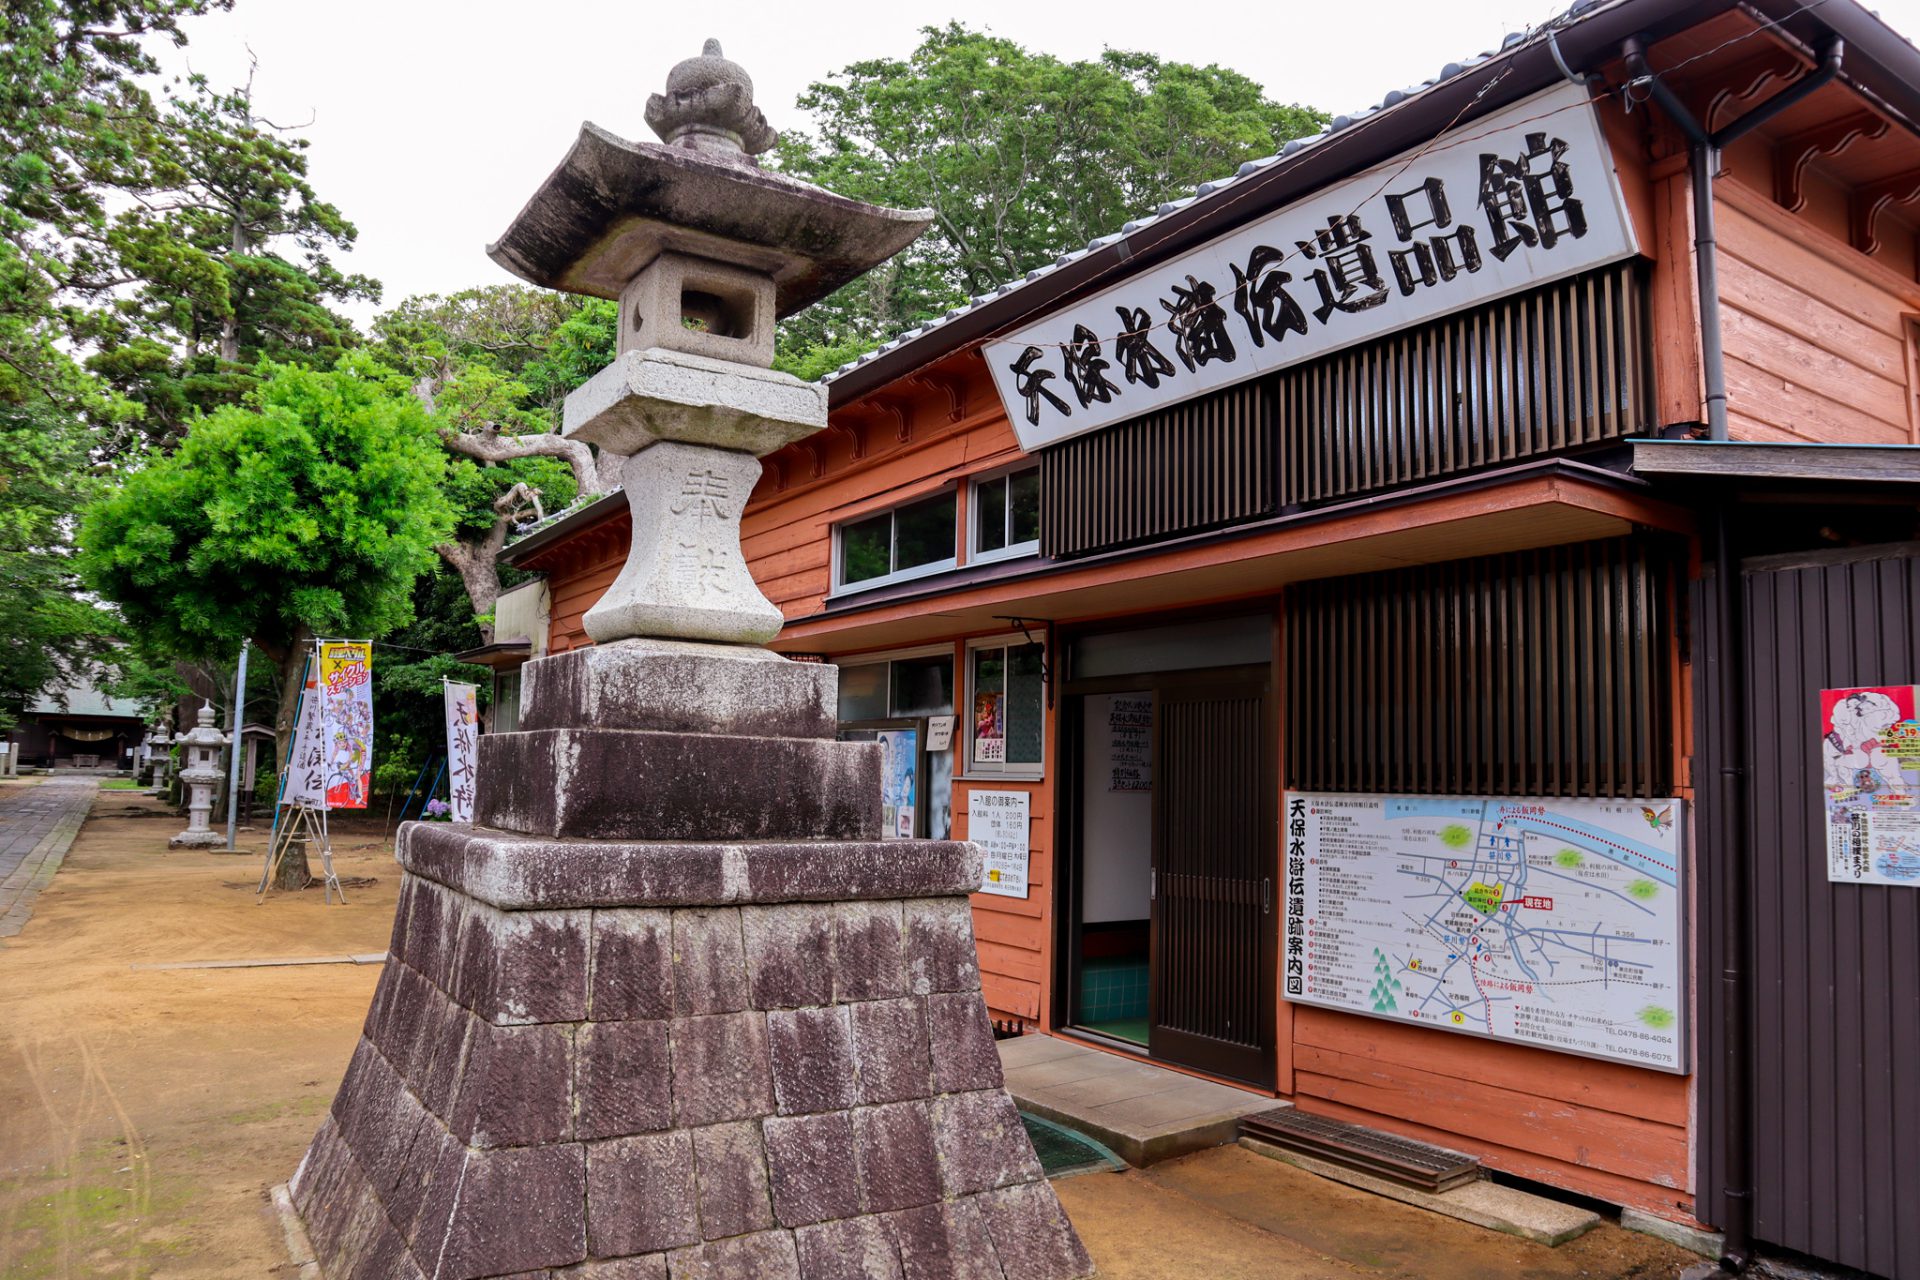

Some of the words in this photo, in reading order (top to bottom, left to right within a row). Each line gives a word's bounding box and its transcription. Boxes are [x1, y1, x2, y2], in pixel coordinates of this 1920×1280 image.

[1008, 131, 1588, 426] 天保水滸伝遺品館
[327, 672, 369, 696] ステーション
[328, 661, 366, 685] サイクル
[1005, 811, 1023, 820] 200円
[1287, 799, 1306, 995] 天保水滸伝遺跡案内図
[1524, 898, 1552, 909] 現在地
